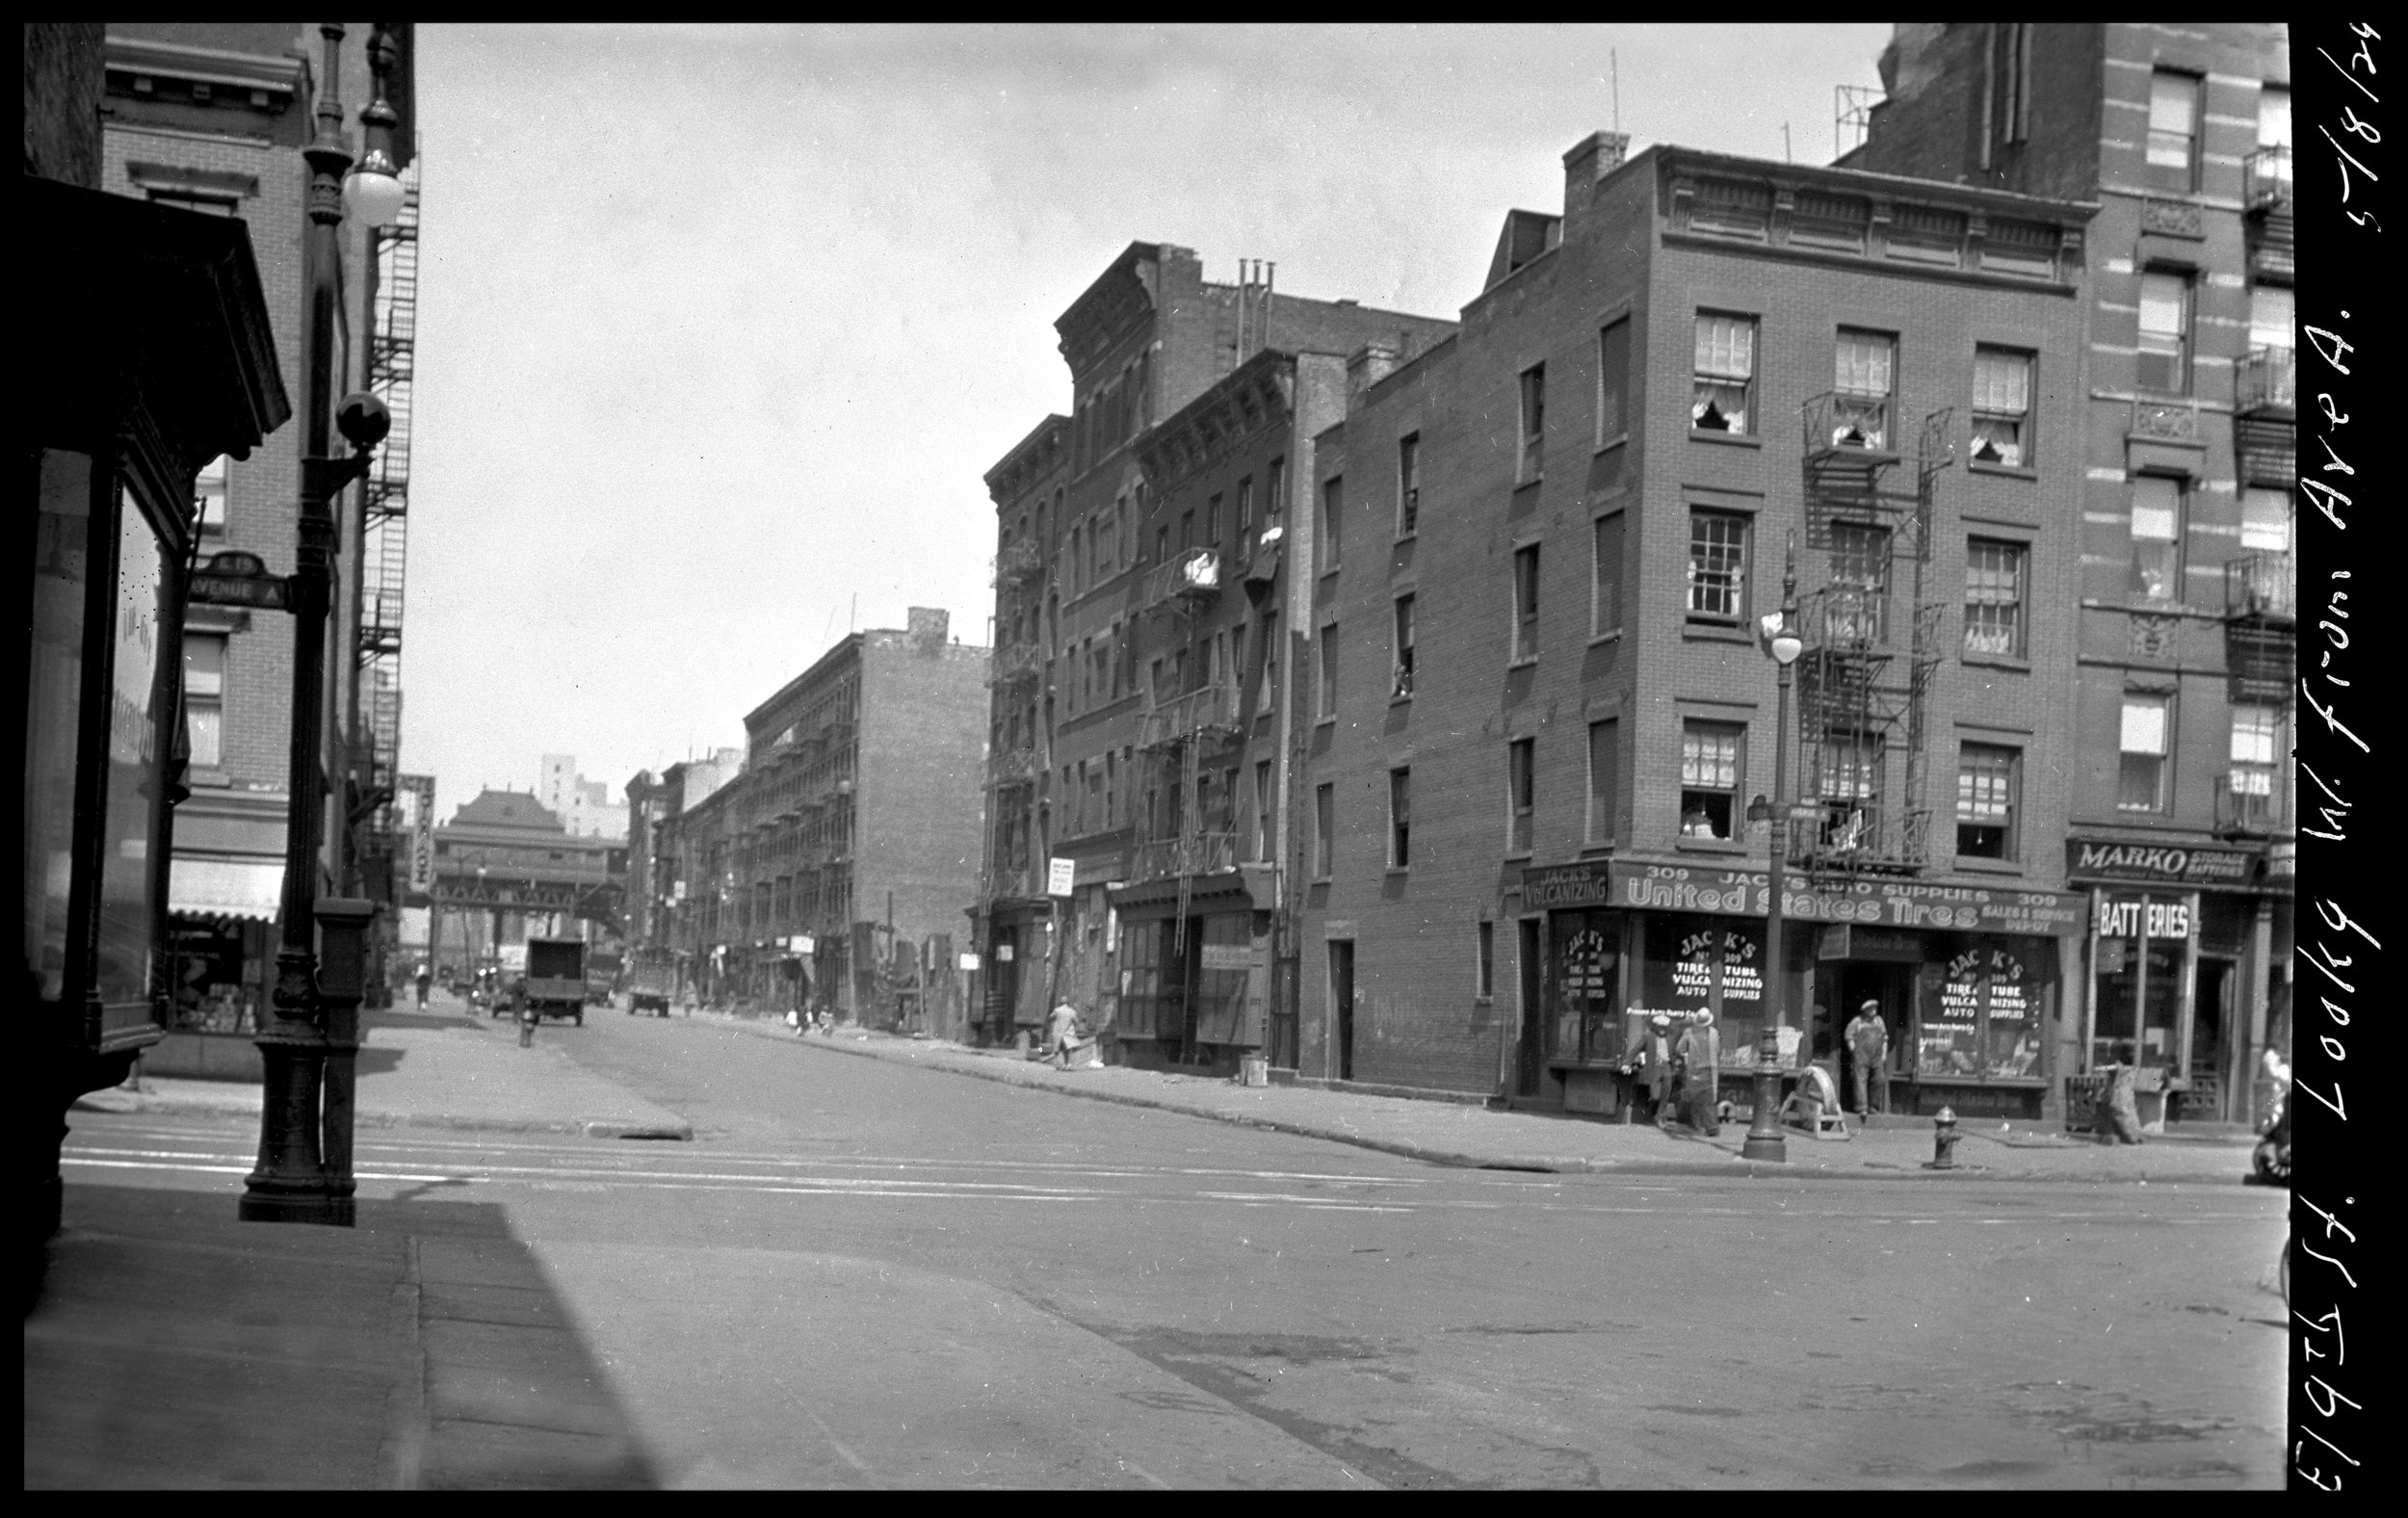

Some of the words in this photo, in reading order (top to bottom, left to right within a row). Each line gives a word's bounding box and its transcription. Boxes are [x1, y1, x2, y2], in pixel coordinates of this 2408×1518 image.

[265, 587, 277, 600] A
[2079, 844, 2186, 874] MARKO
[1525, 877, 1606, 905] VULCANIZING
[1646, 866, 1689, 880] 309
[1718, 872, 1807, 890] JAC'S
[1882, 883, 1990, 903] SUPPLIES
[2019, 893, 2057, 907] 309
[1628, 877, 1746, 911] United
[1887, 896, 1979, 929] Tires
[1725, 965, 1758, 977] TUBE
[1676, 986, 1708, 997] AUTO
[1722, 988, 1761, 1001] SUPPLIES
[1991, 985, 2022, 997] TUBE
[1944, 1008, 1976, 1018] AUTO
